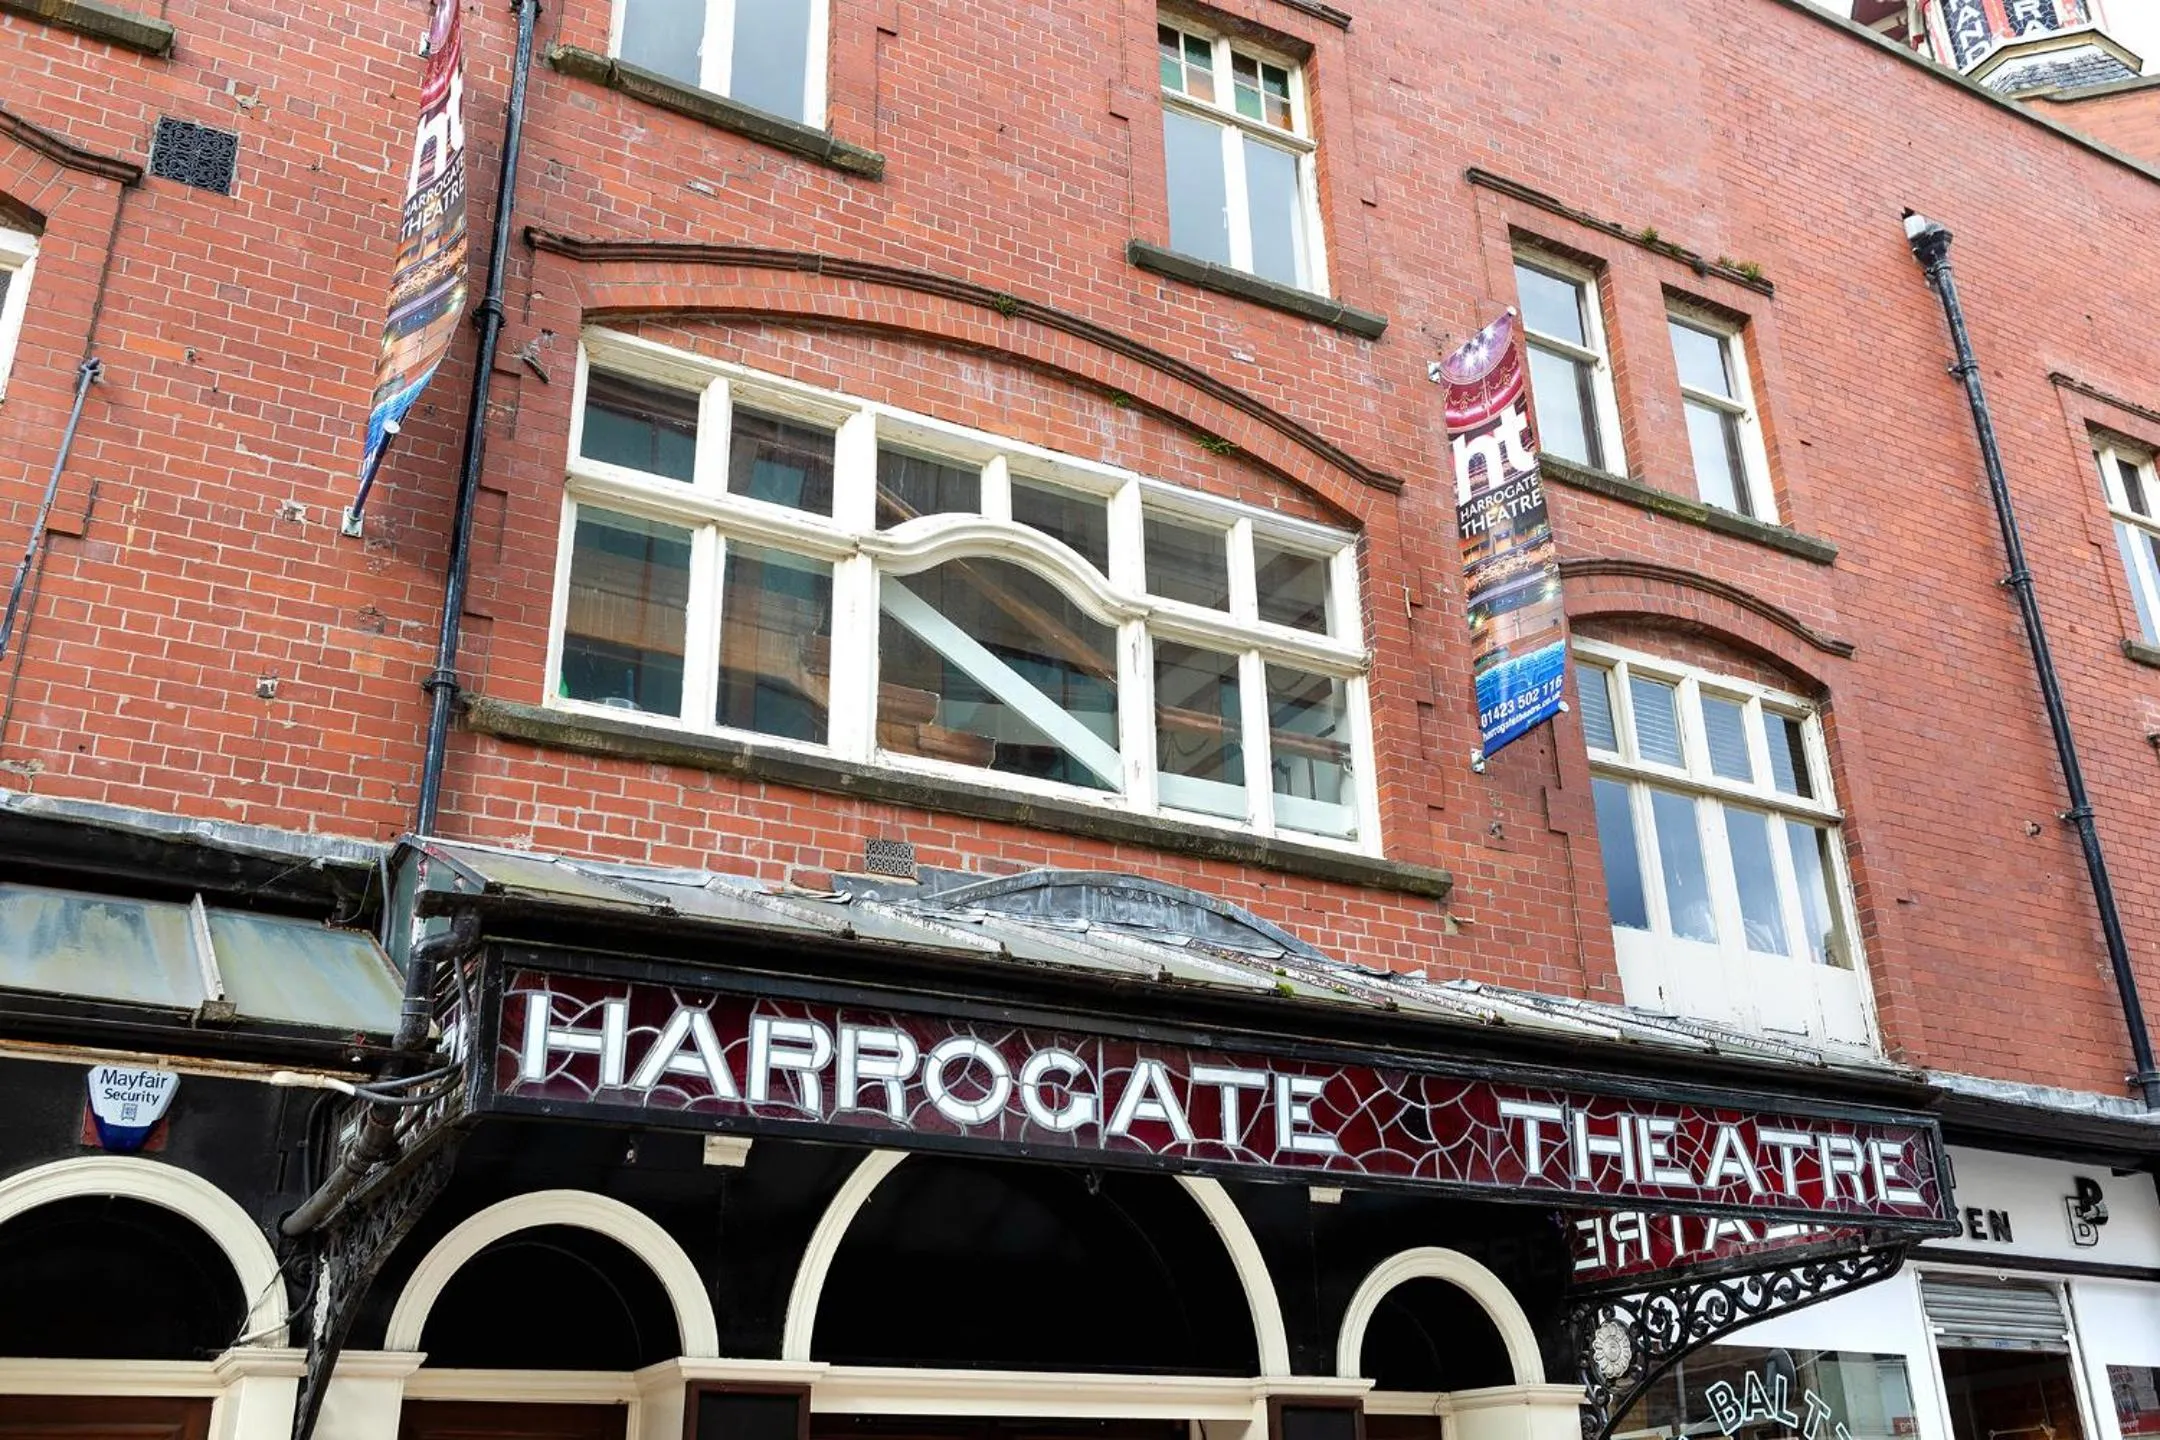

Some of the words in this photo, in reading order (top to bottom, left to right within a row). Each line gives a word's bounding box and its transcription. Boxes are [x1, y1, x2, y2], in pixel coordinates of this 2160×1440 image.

[401, 167, 465, 243] THEATRE
[1460, 472, 1538, 523] HARROGATE
[1461, 488, 1543, 540] THEATRE
[1481, 699, 1515, 728] 01423
[1517, 688, 1540, 709] 502
[100, 1069, 168, 1091] Mayfair
[103, 1088, 160, 1106] Security
[521, 990, 1344, 1155] HARROGATE
[1498, 1097, 1924, 1205] THEATRE
